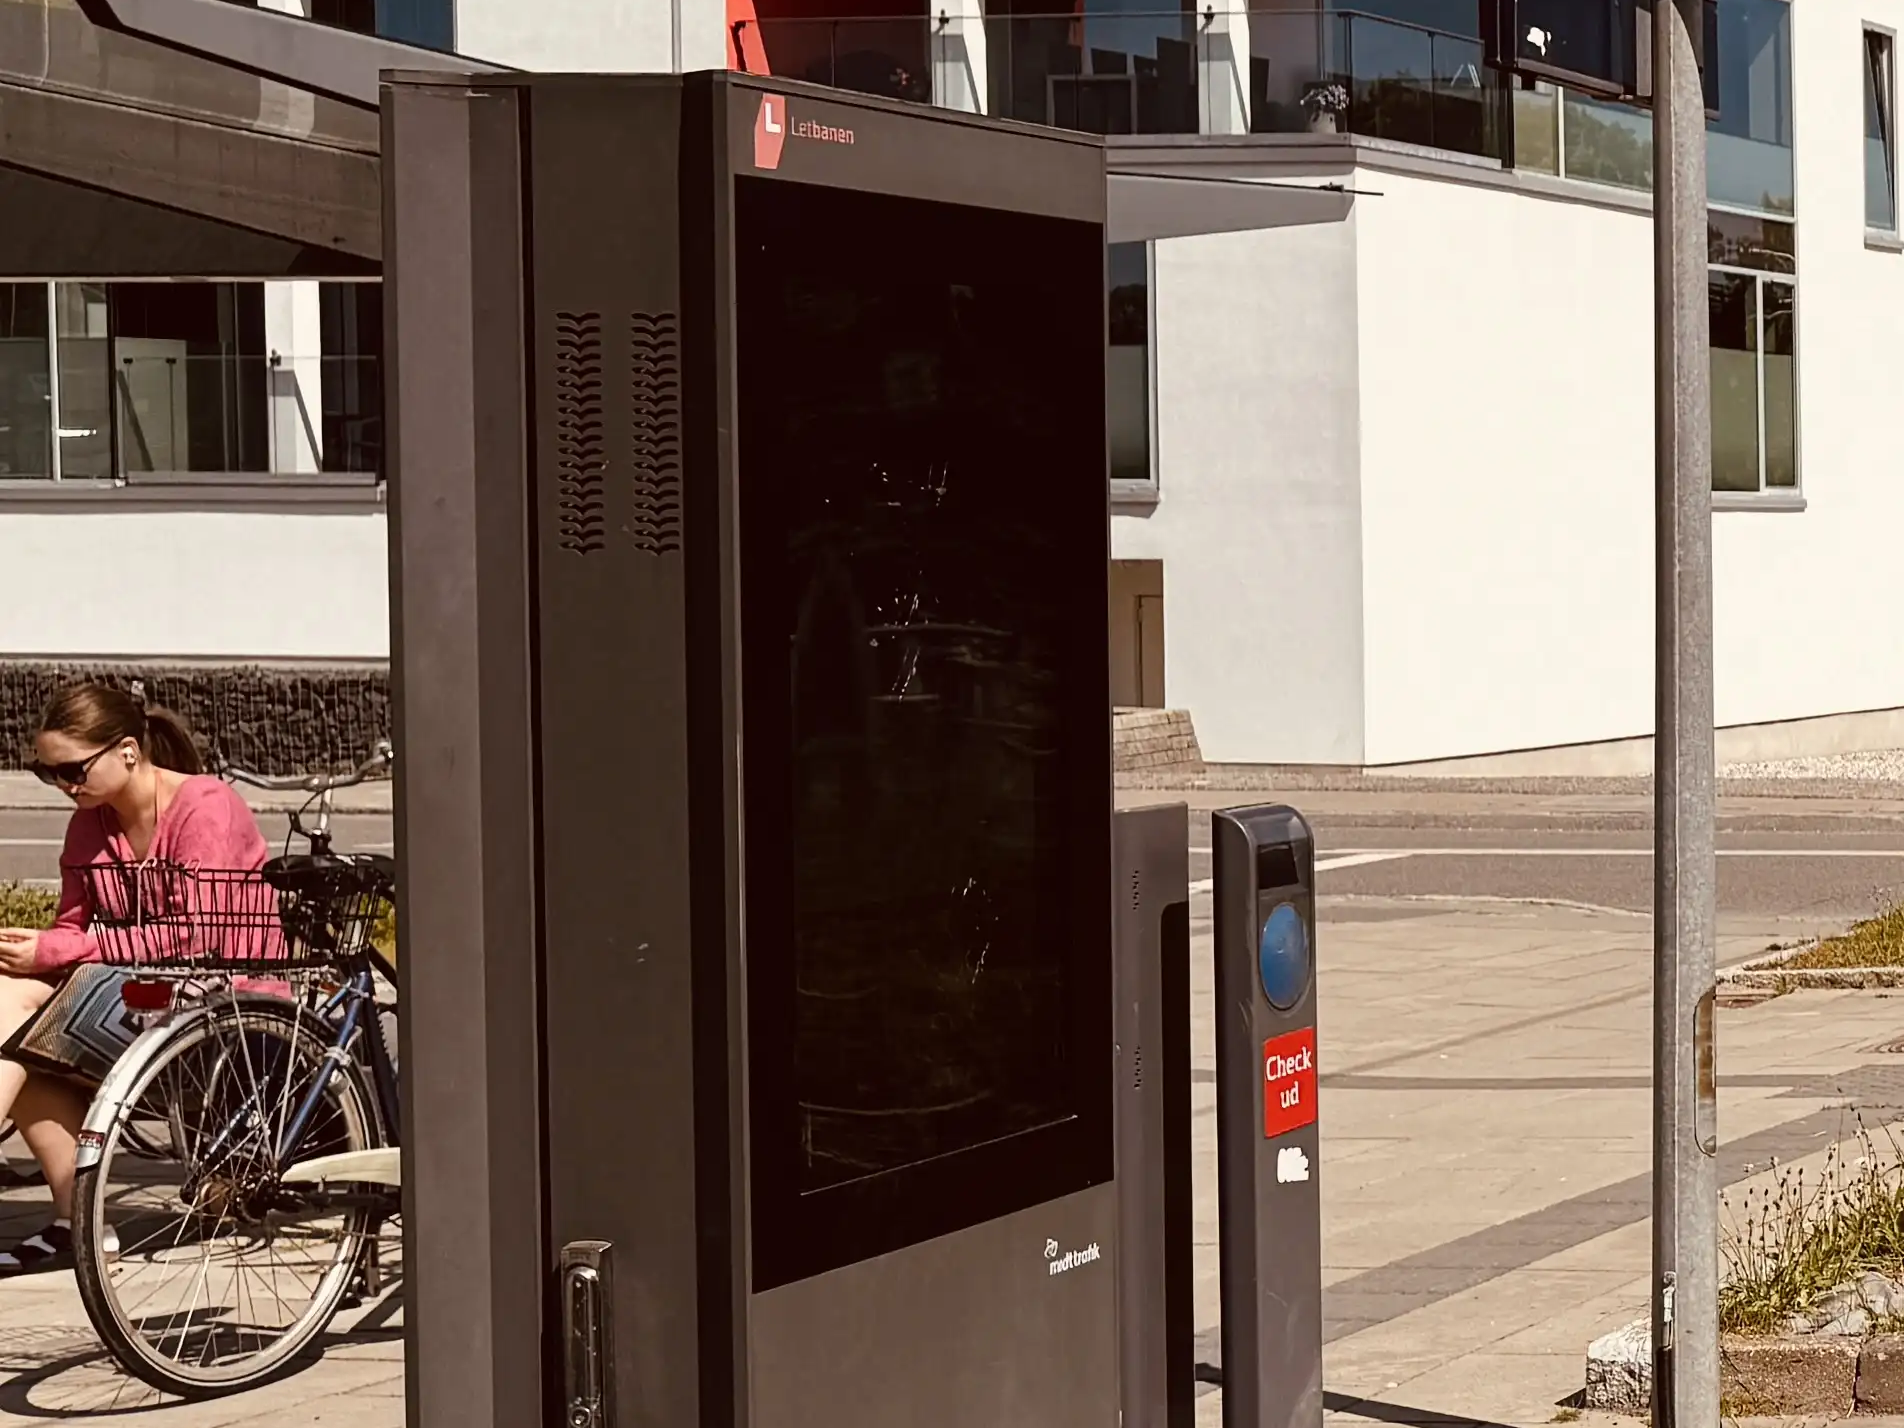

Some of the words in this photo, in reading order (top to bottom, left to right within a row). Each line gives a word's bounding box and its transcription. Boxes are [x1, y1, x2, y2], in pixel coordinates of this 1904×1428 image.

[791, 116, 855, 144] Letbanen
[1266, 1046, 1312, 1081] Check
[1280, 1081, 1300, 1108] ud
